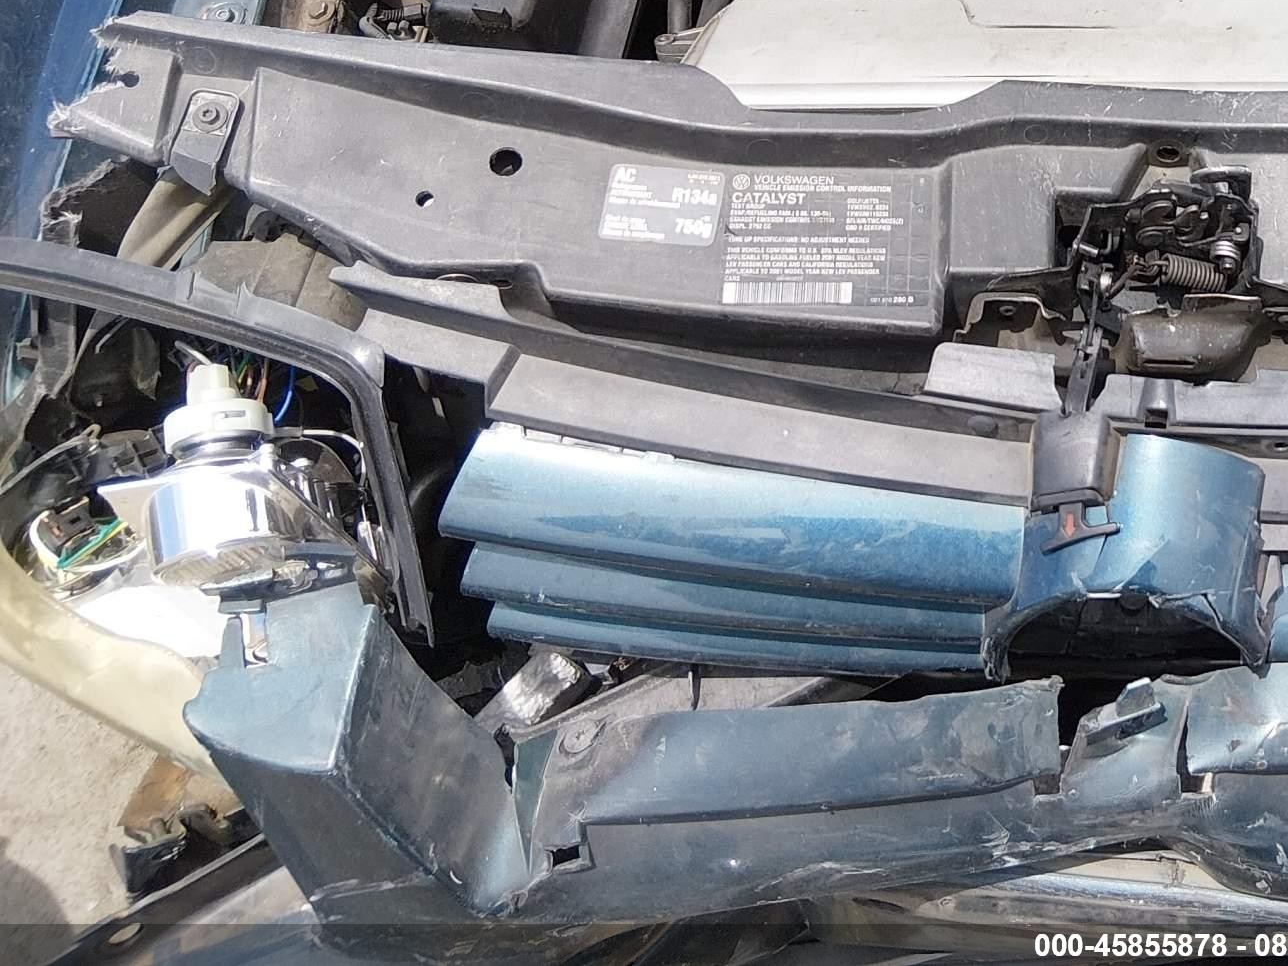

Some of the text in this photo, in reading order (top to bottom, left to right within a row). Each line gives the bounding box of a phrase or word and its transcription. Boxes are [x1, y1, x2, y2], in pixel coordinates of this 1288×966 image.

[614, 167, 637, 183] AC
[754, 174, 834, 185] VOLKSWAGEN
[672, 186, 718, 206] R134a
[732, 192, 806, 205] CATALYST
